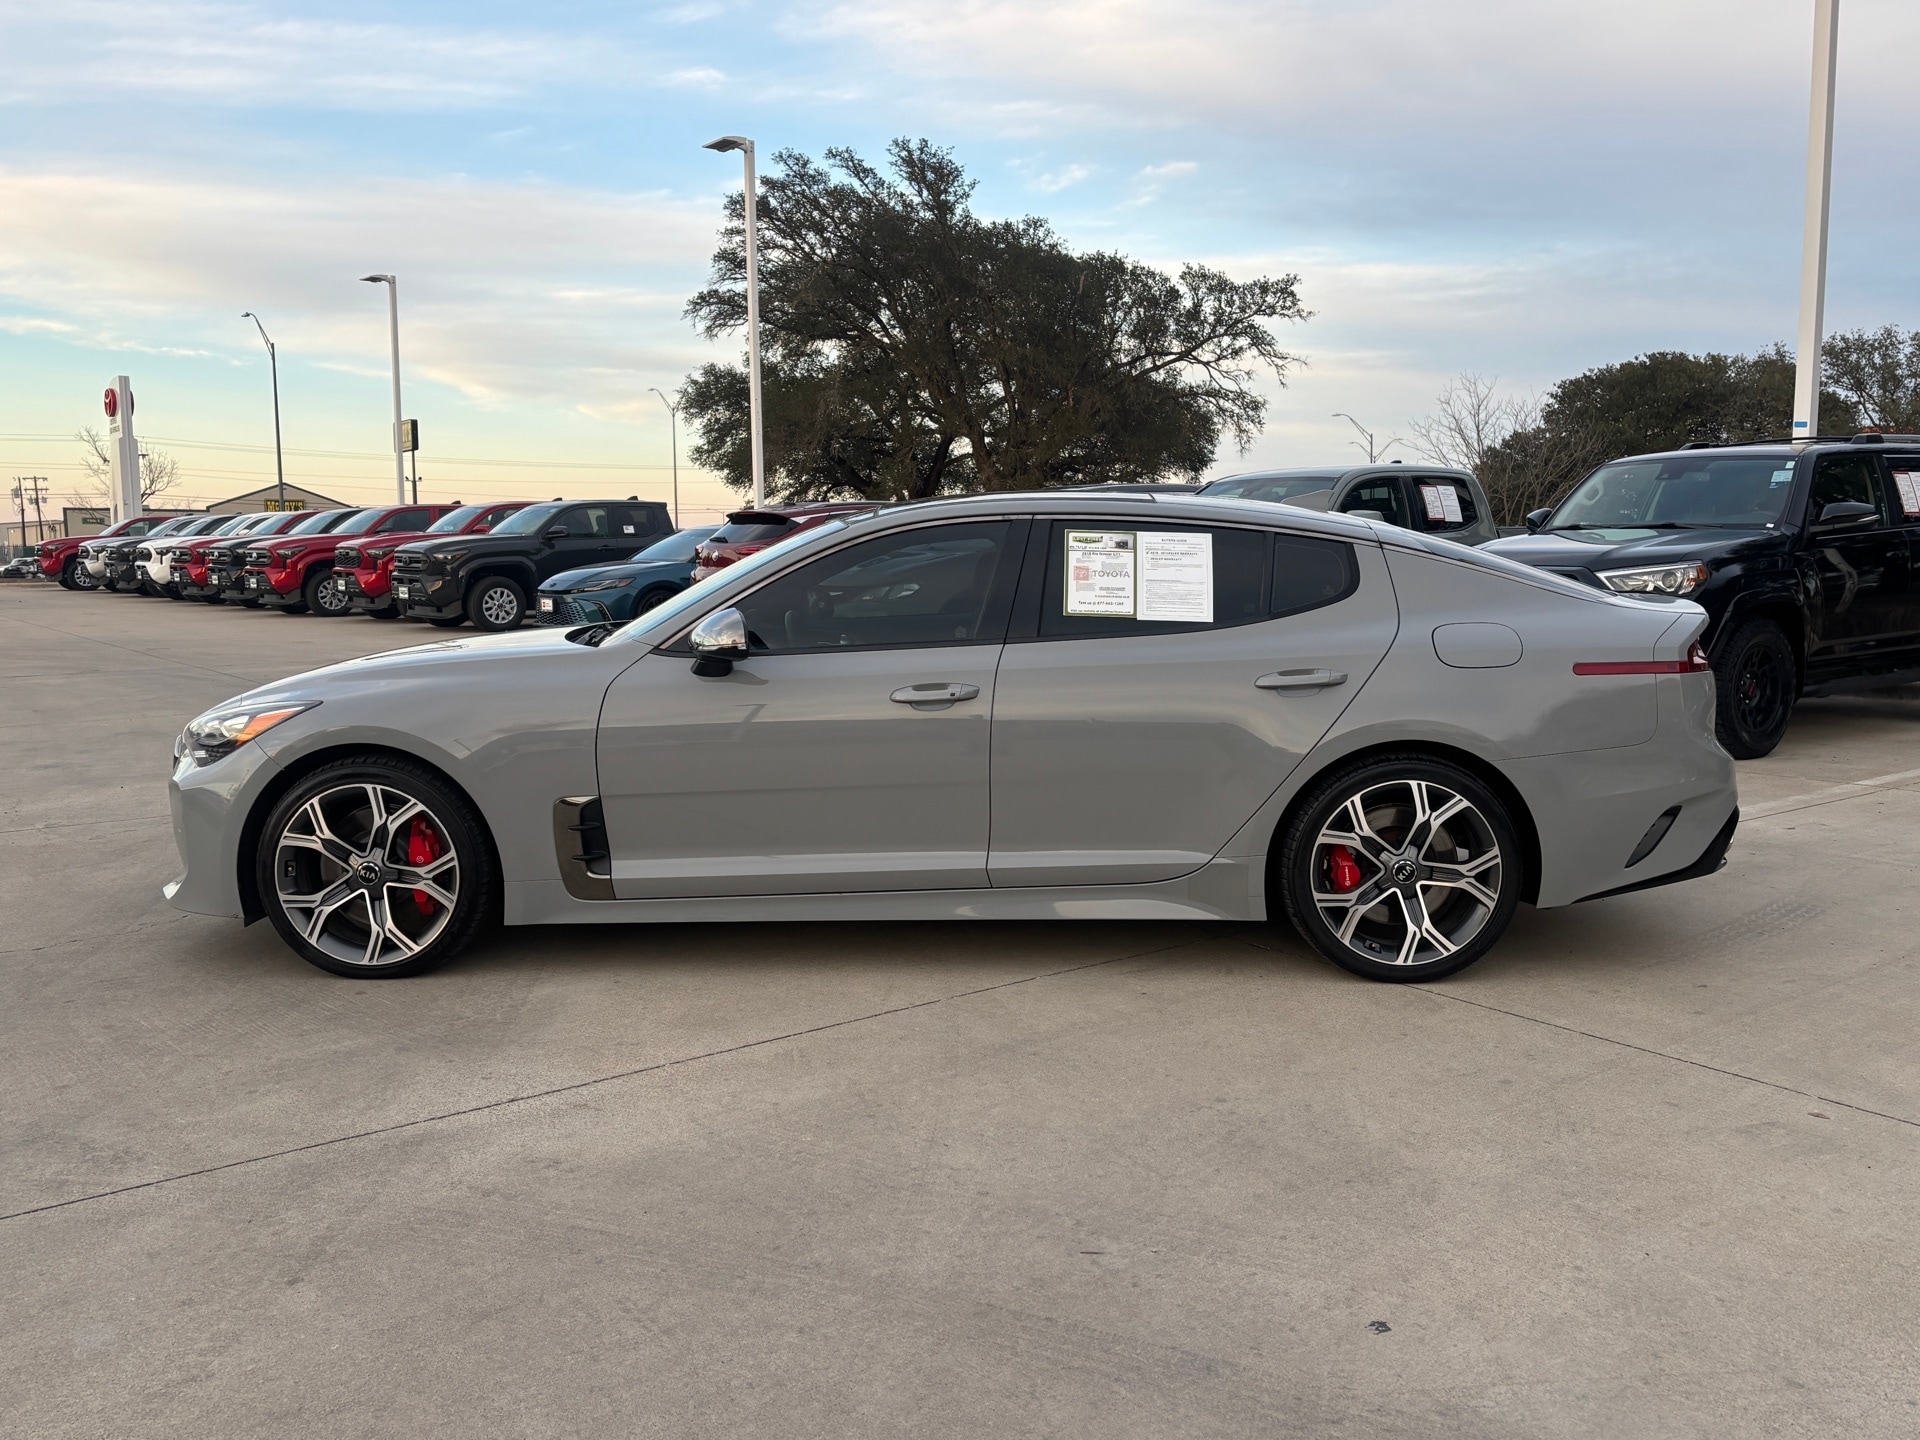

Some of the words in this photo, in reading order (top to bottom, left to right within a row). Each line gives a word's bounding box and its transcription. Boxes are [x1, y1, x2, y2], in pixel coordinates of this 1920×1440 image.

[267, 501, 303, 512] McOY'S
[1092, 570, 1130, 578] TOYOTA
[360, 868, 376, 880] KIA
[1397, 866, 1413, 880] KIA
